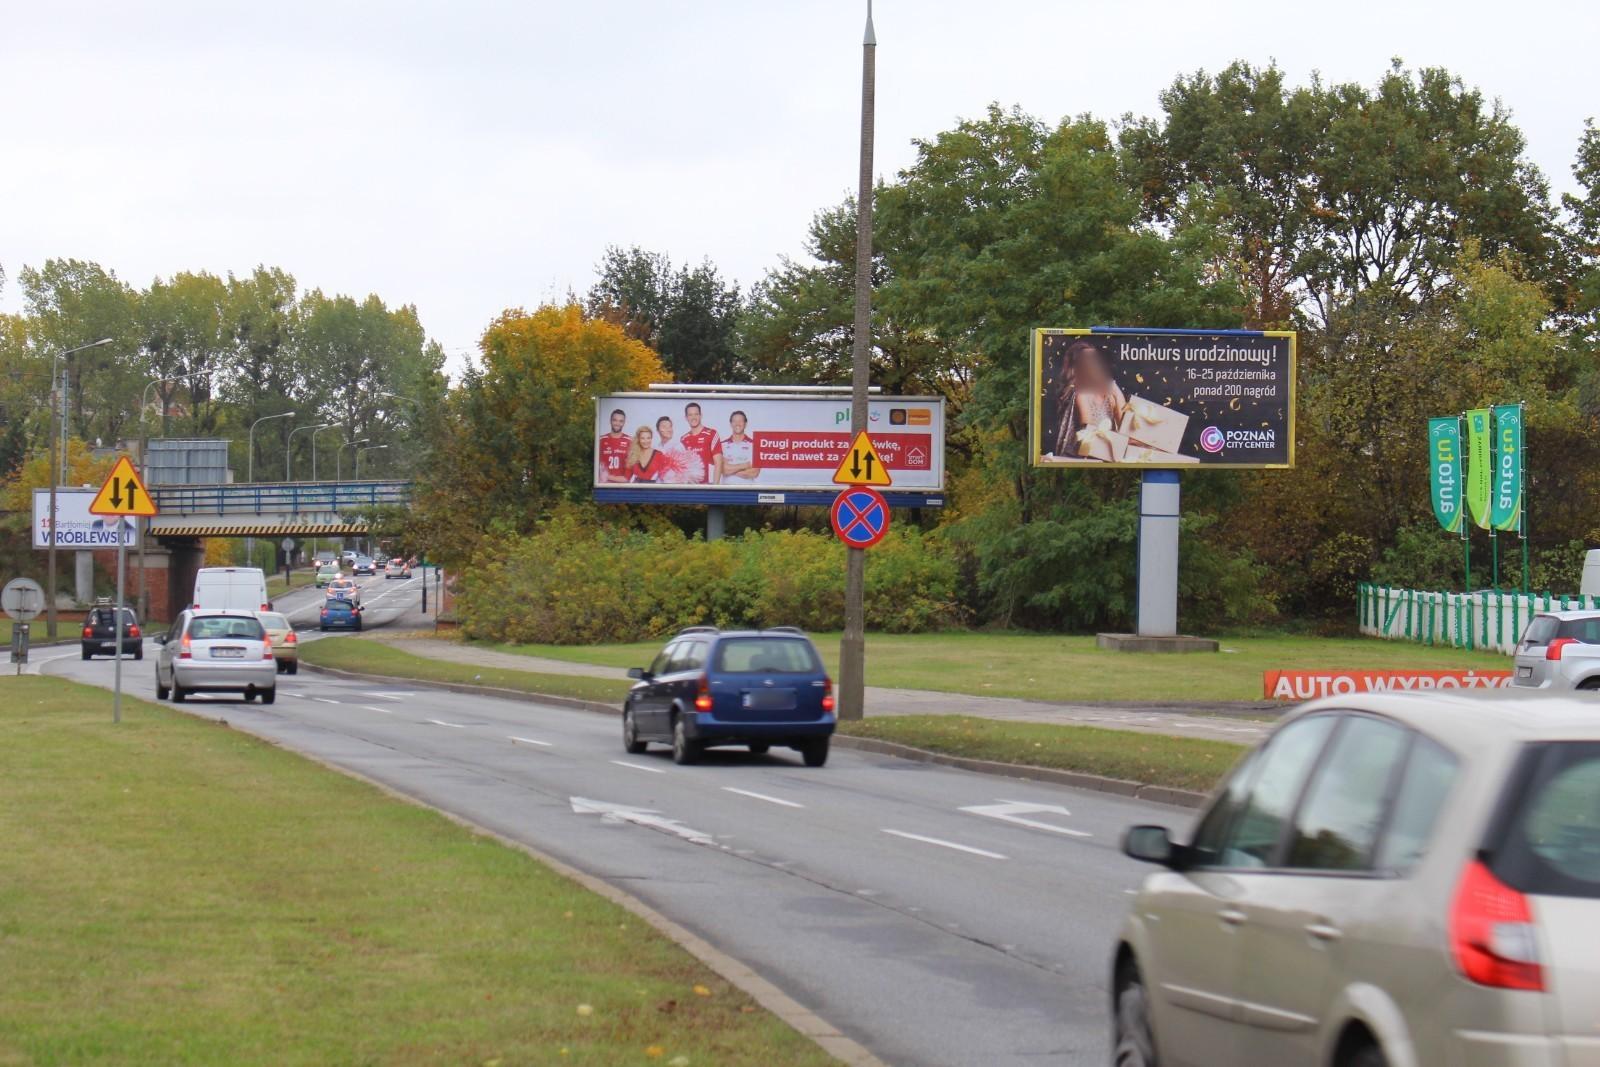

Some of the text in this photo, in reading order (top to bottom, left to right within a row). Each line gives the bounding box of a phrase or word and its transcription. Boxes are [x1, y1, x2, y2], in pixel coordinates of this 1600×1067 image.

[1120, 343, 1180, 362] Konkurs
[1186, 368, 1276, 382] 16-25 października
[1193, 385, 1276, 398] ponad 200 nagród
[1226, 429, 1275, 441] POZNAŃ
[759, 438, 789, 453] Drugi
[791, 439, 834, 453] produkt
[836, 441, 849, 450] za
[1226, 441, 1275, 449] CITY CENTER
[608, 456, 620, 469] 20
[759, 451, 839, 462] trzeci nawet za
[56, 519, 91, 530] Bartłomiej
[1273, 675, 1356, 699] AUTO
